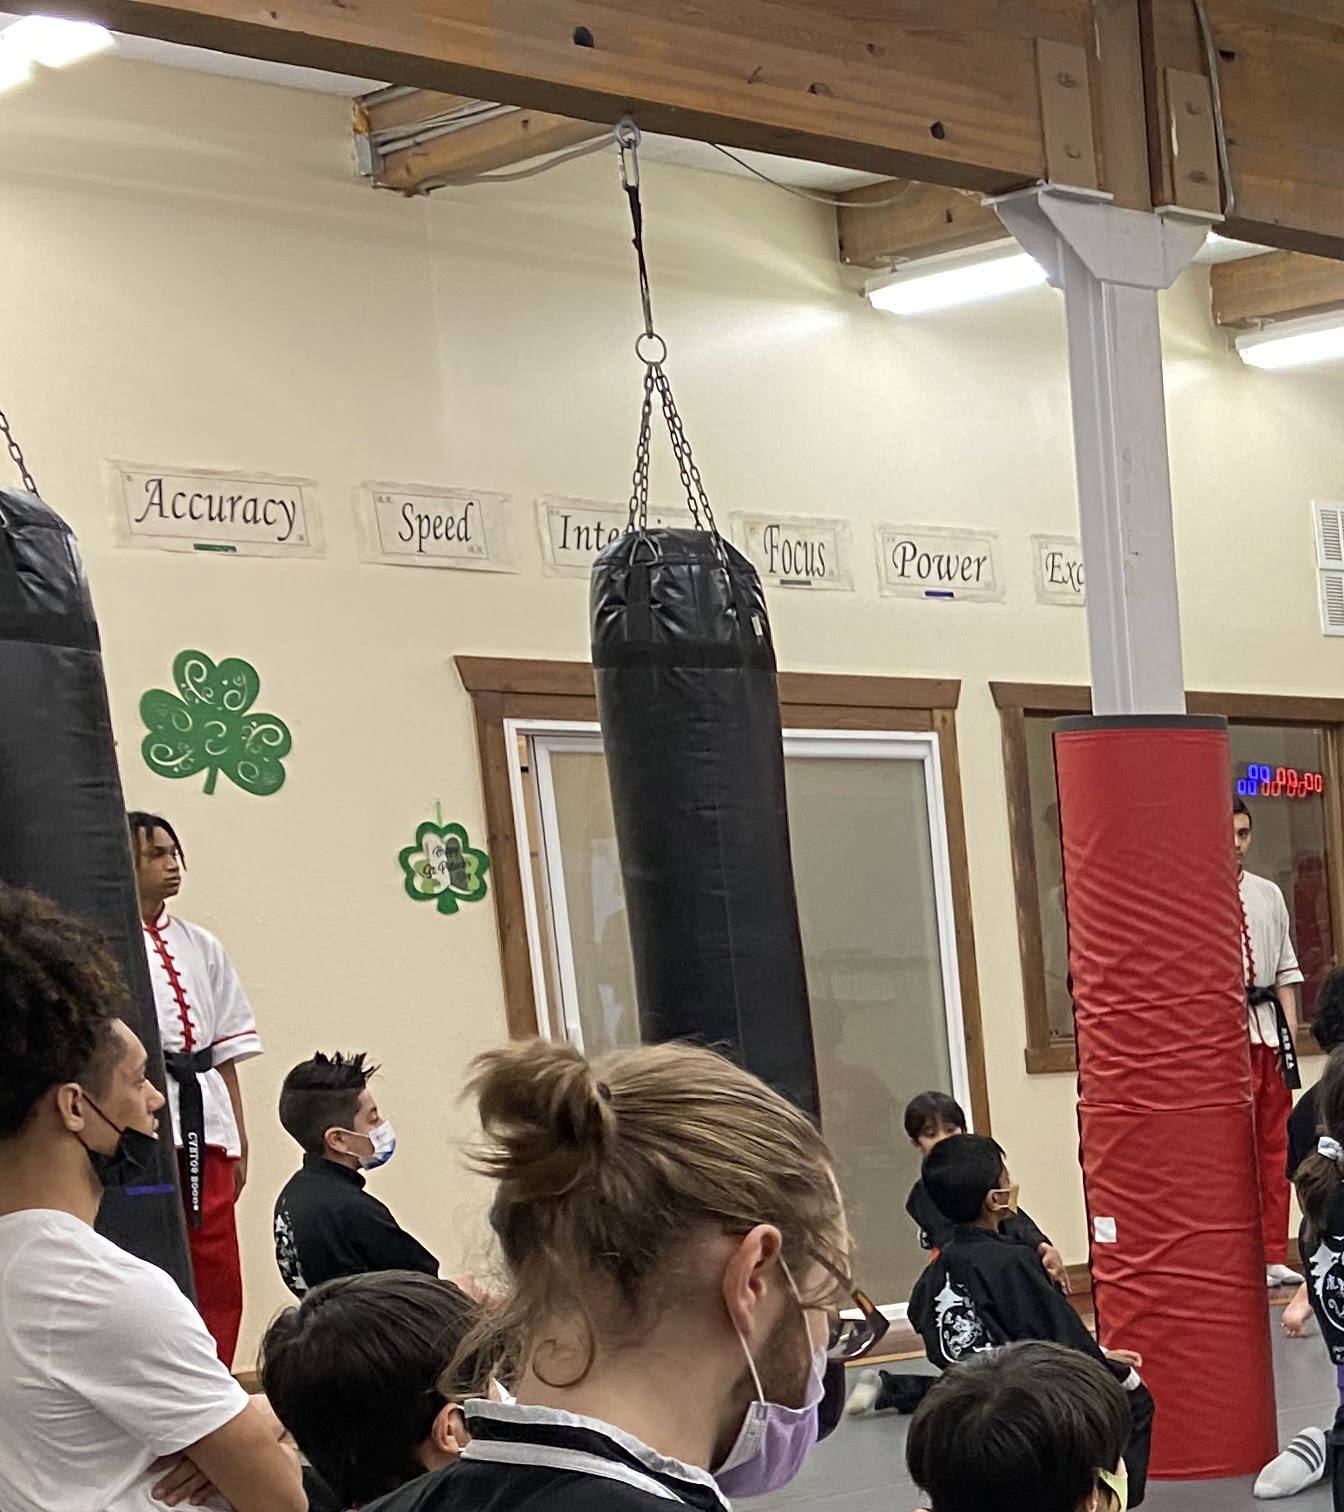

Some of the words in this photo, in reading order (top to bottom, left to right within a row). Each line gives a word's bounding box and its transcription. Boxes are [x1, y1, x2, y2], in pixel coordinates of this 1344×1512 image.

[135, 477, 297, 542] Accuracy
[397, 501, 475, 554] Speed
[763, 524, 826, 578] Focus
[892, 541, 988, 582] Power
[1045, 551, 1085, 593] Exc
